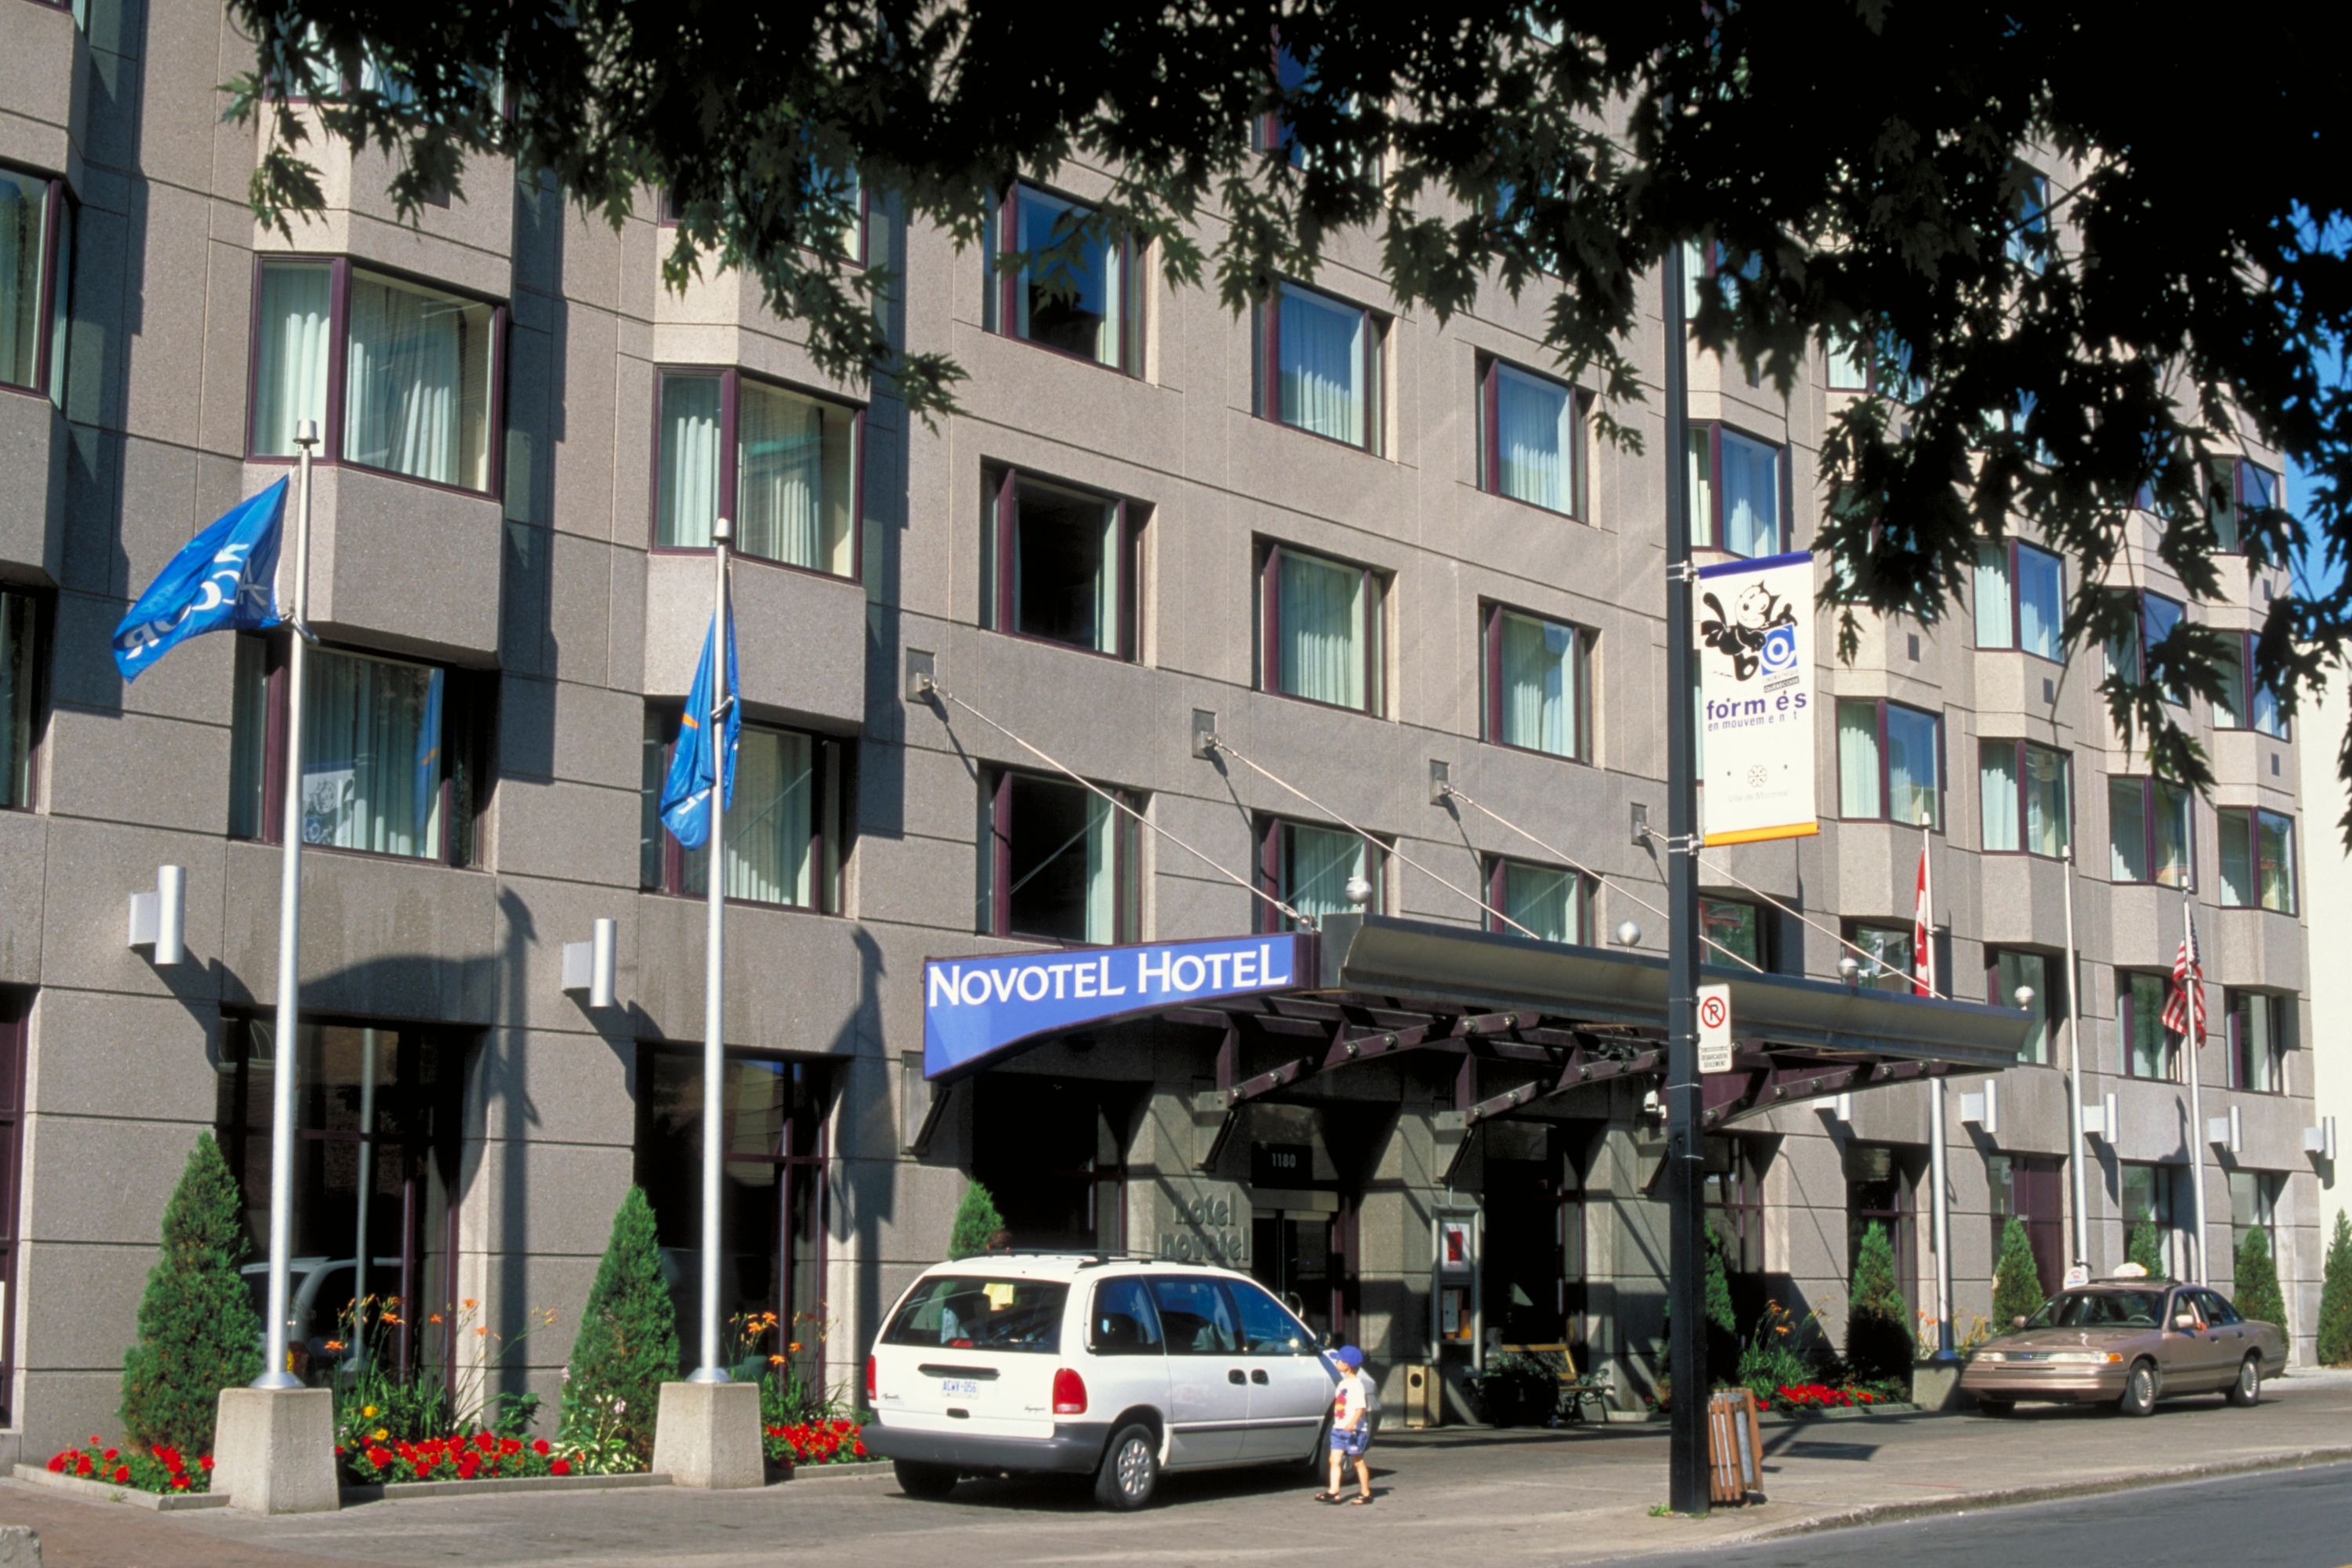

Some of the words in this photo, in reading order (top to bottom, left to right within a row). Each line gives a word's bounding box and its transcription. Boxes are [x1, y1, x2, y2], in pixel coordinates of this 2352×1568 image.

[1708, 721, 1719, 731] en
[929, 956, 1126, 1007] NOVOTEL
[1138, 944, 1288, 993] HOTEL
[1272, 1153, 1296, 1167] 1180
[1174, 1191, 1236, 1226] hotel
[1160, 1226, 1249, 1261] novotel
